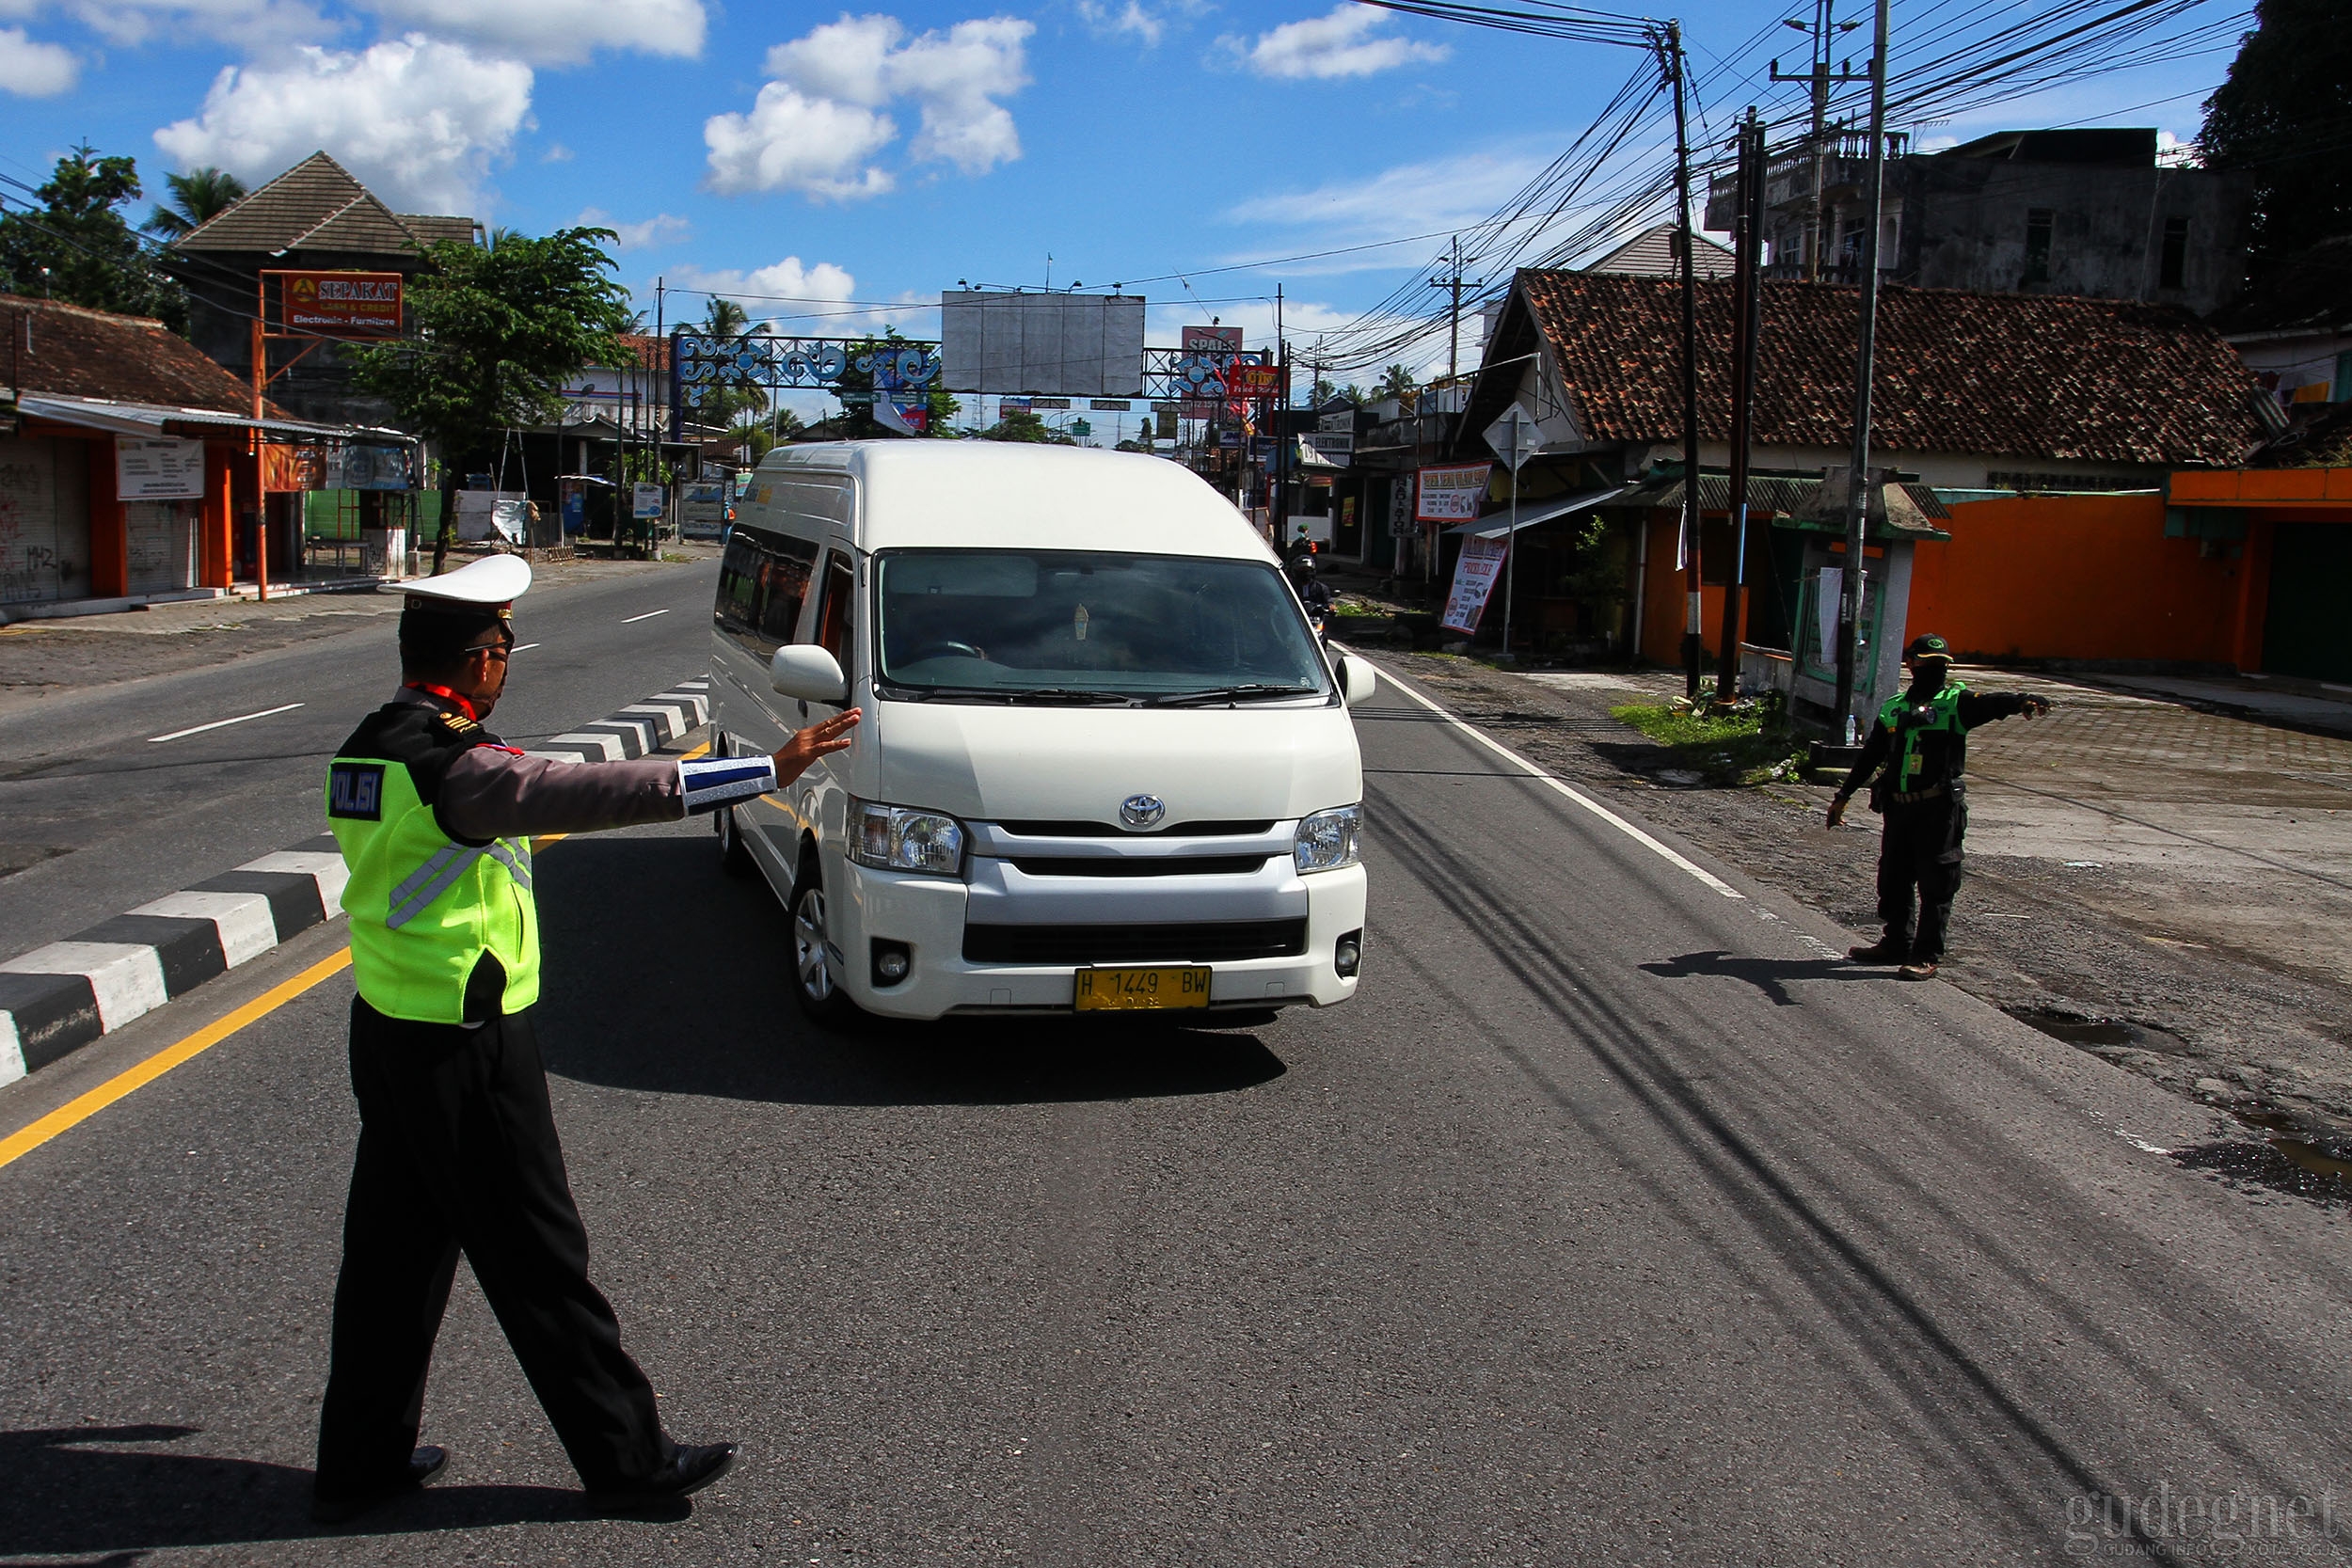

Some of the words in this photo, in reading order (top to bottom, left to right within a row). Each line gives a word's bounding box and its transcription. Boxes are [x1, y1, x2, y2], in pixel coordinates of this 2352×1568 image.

[318, 280, 398, 301] SEPAKAT
[360, 304, 395, 313] CREDIT
[294, 314, 342, 325] Electronic
[351, 316, 395, 326] Furniture
[331, 771, 379, 812] POLISI
[1082, 973, 1092, 995] H
[1114, 972, 1159, 995] 1449
[1182, 971, 1206, 993] BW
